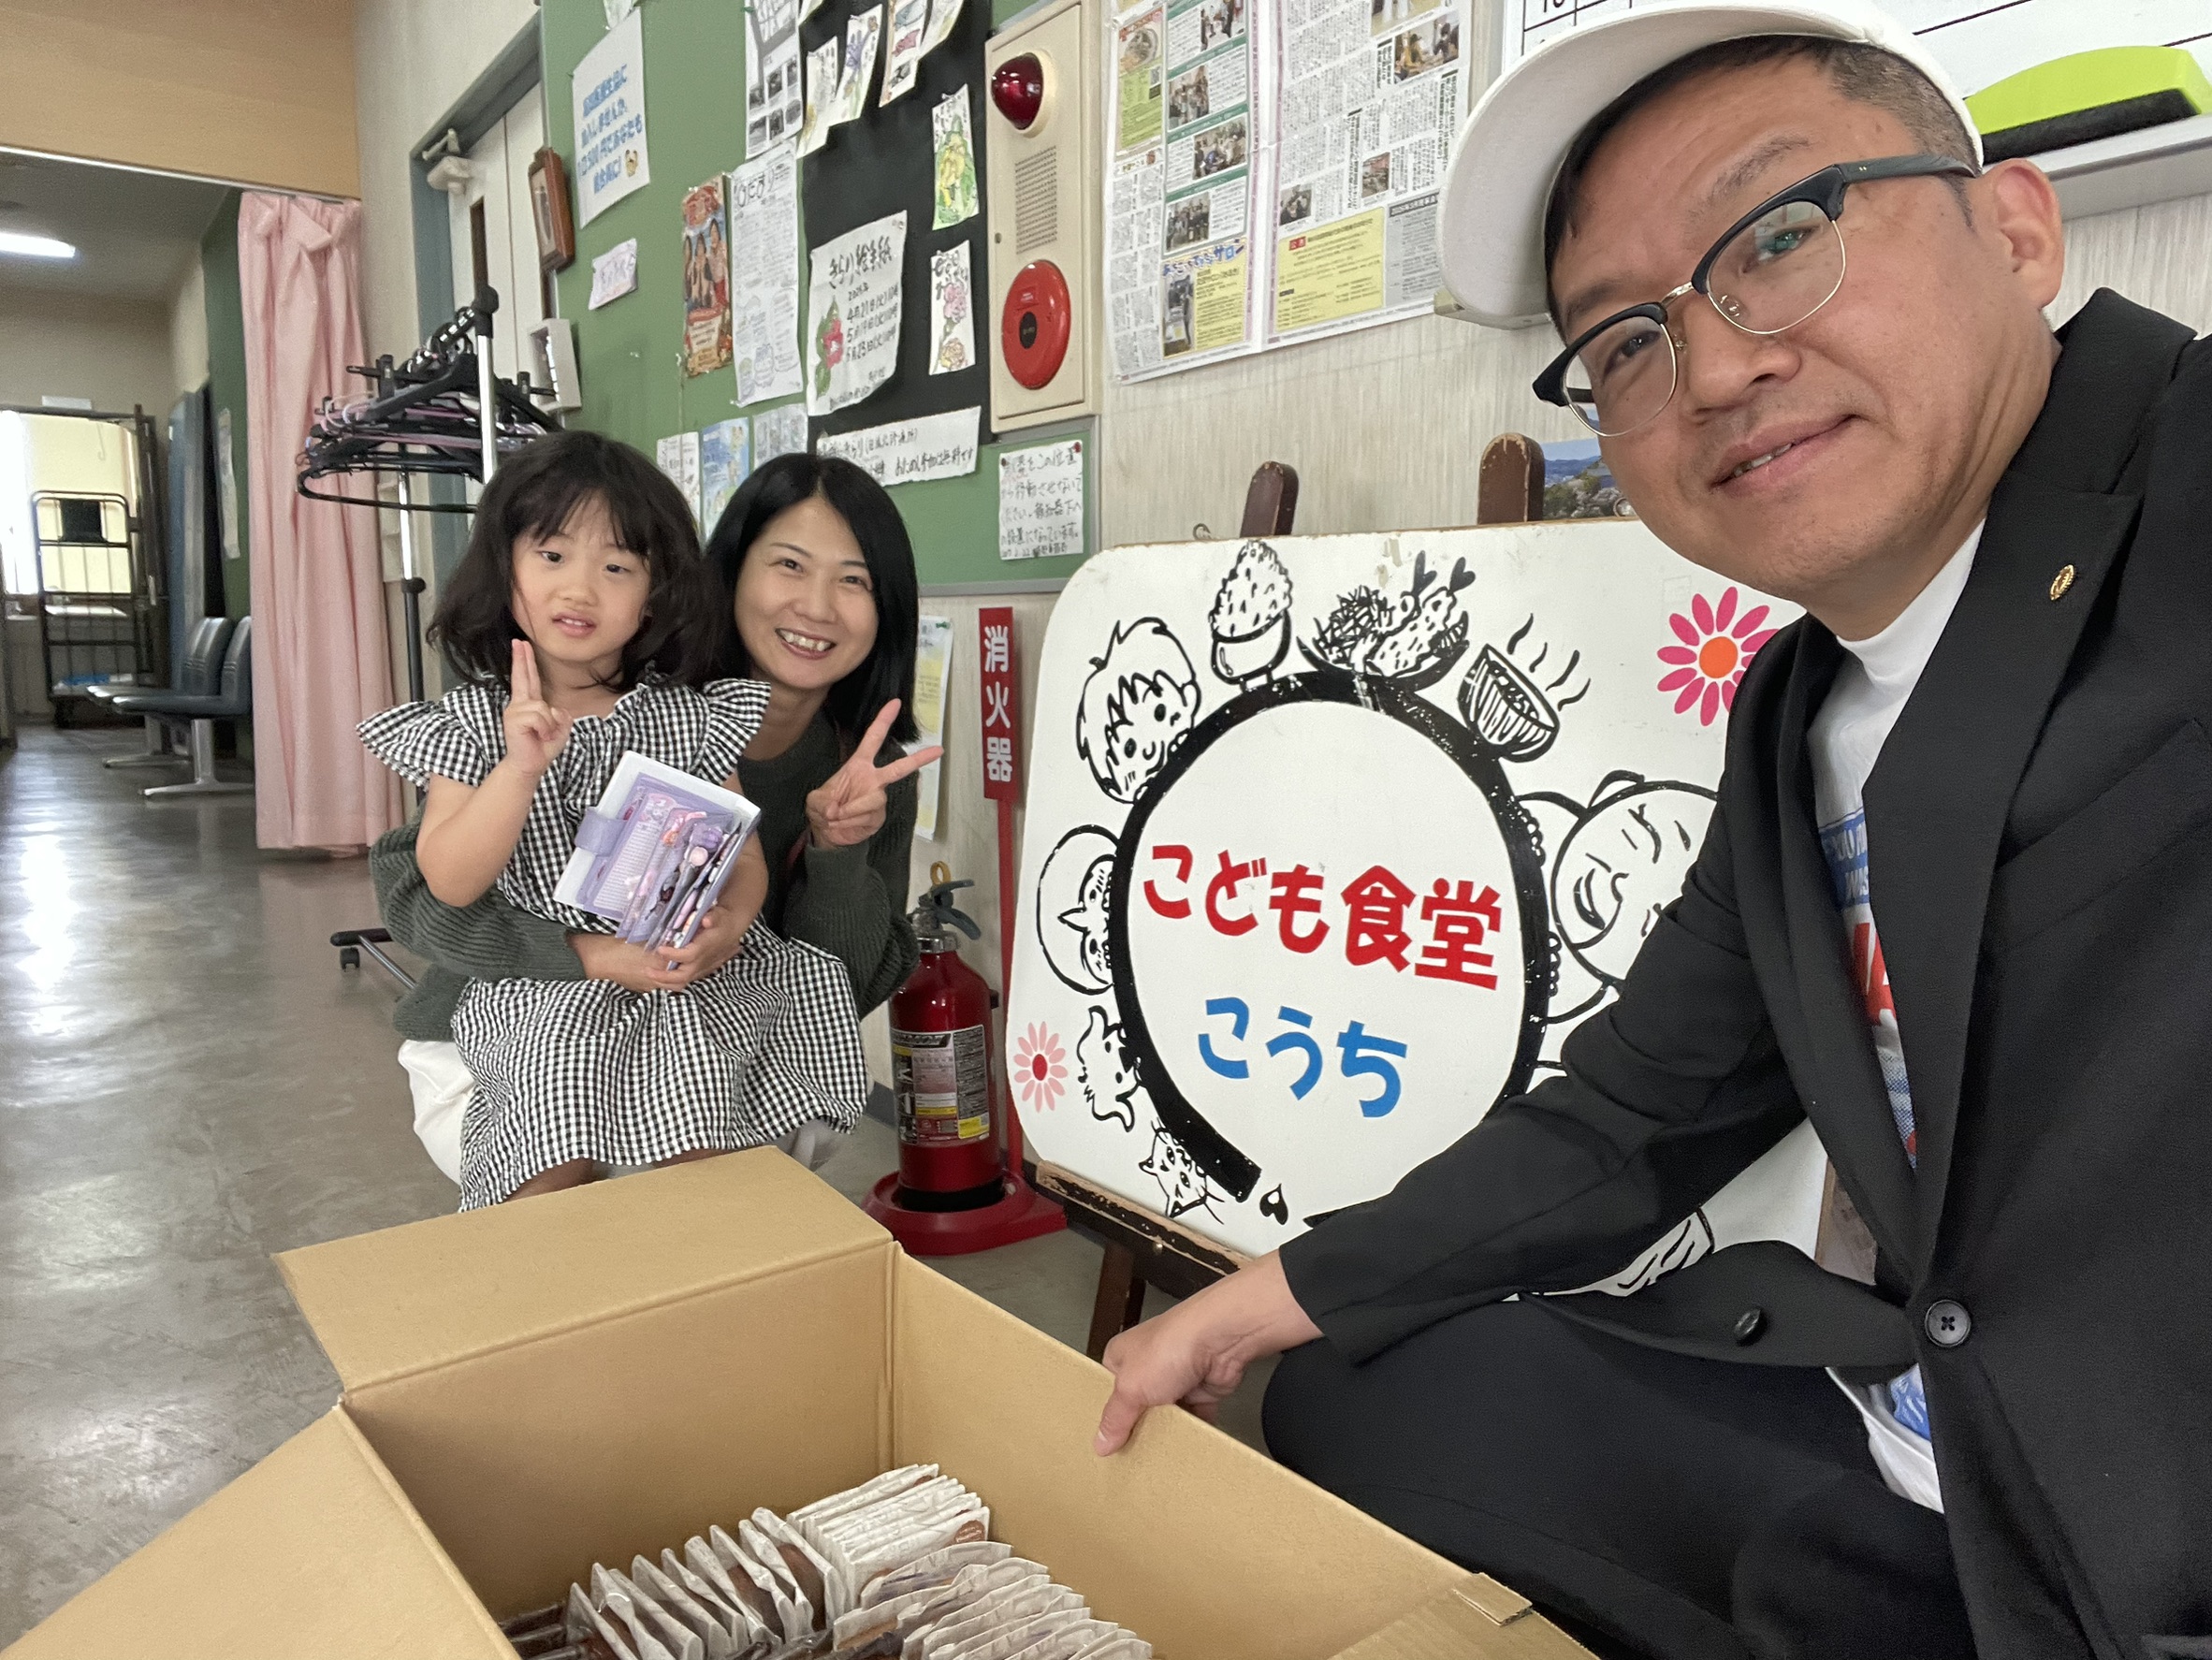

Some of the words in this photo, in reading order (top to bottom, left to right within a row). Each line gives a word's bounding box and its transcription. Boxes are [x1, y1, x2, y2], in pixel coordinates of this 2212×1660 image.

[983, 625, 1013, 782] 消火器
[1142, 844, 1502, 990] こども食堂
[1197, 995, 1408, 1118] こうち
